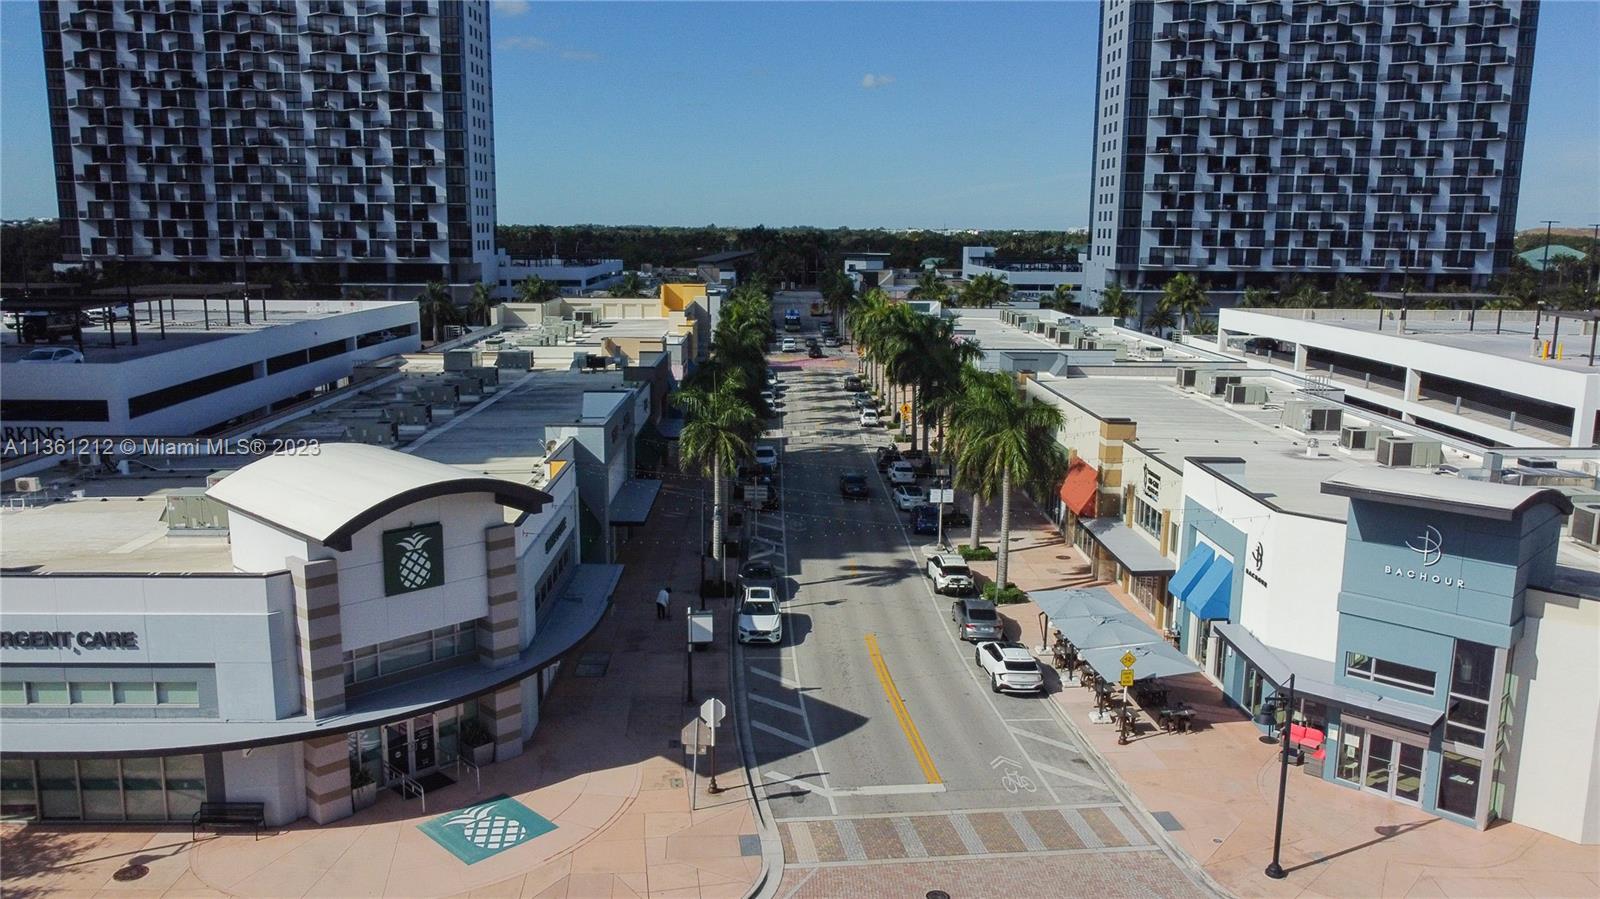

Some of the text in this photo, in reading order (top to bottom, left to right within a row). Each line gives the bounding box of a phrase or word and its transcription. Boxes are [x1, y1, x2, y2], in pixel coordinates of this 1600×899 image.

[1, 426, 65, 442] RKING
[1384, 565, 1466, 589] BACHOUR
[76, 631, 139, 649] CARE
